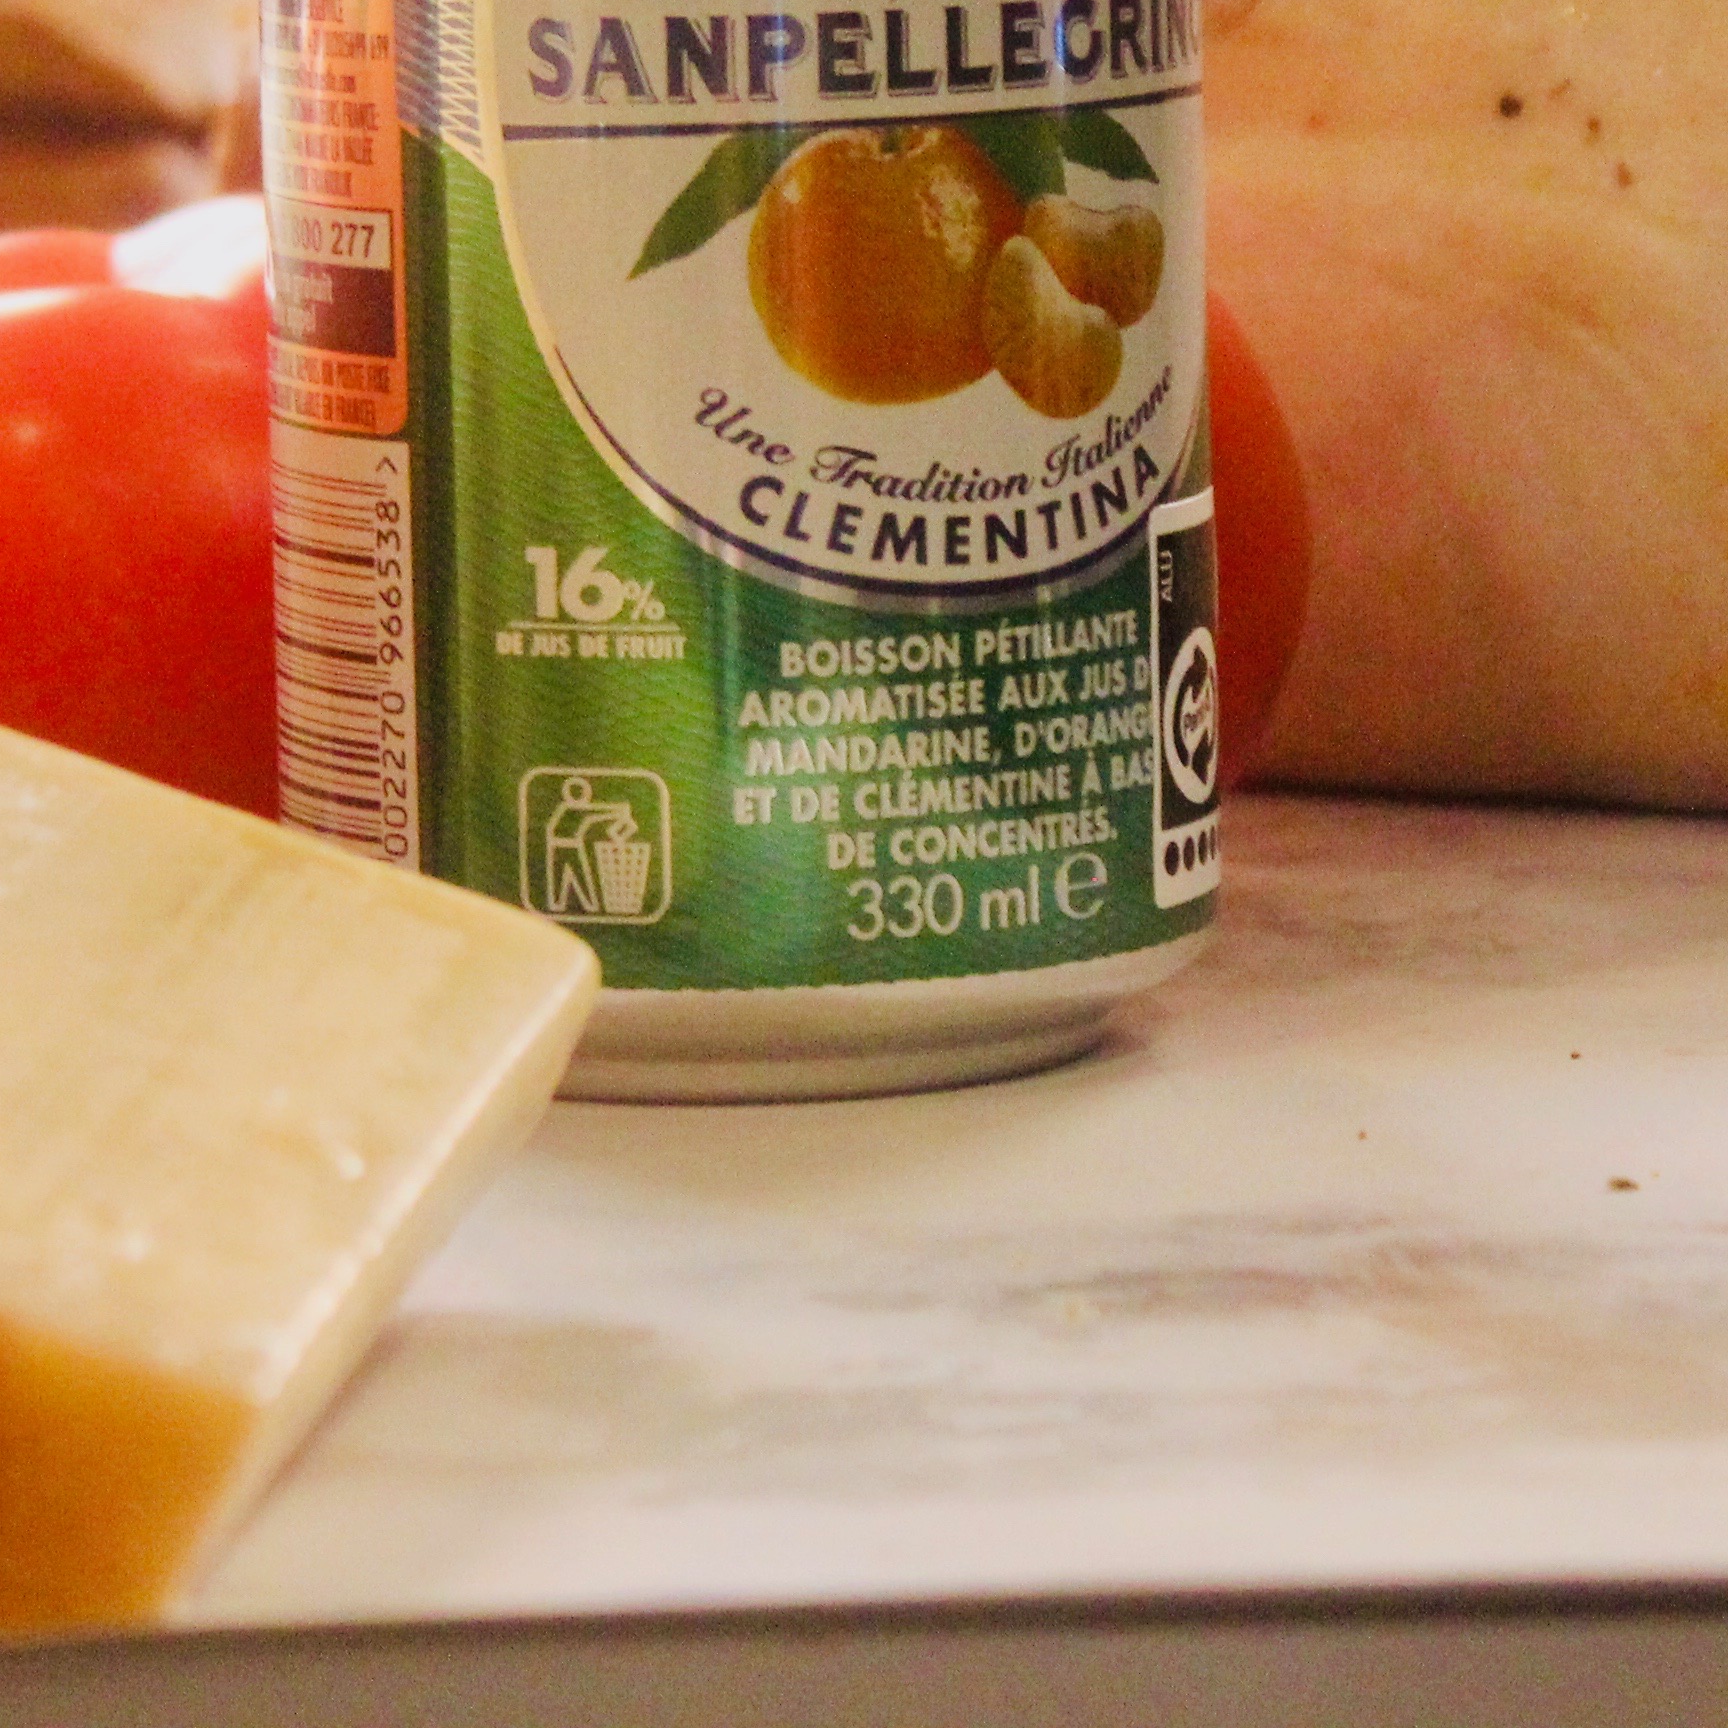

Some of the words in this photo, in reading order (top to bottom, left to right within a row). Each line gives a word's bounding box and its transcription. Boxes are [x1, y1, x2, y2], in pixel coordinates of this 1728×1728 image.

[330, 220, 374, 258] 277
[693, 386, 798, 466] Une
[810, 445, 1035, 504] Tradition
[1040, 363, 1172, 488] Italienne
[738, 443, 1161, 567] CLEMENTINA
[524, 546, 666, 621] 16%
[495, 630, 523, 656] DE
[530, 631, 572, 658] JUS
[578, 634, 609, 659] DE
[615, 634, 688, 660] FRUIT
[780, 632, 961, 678] BOISSON
[976, 609, 1138, 667] PÉTILLANTE
[738, 671, 986, 728] AROMATISÉE
[997, 670, 1070, 713] AUX
[1079, 658, 1127, 702] JUS
[1134, 654, 1150, 691] D
[744, 727, 1002, 777] MANDARINE,
[1014, 700, 1153, 758] D'ORANG
[732, 786, 777, 826] ET
[791, 784, 841, 824] DE
[853, 763, 1073, 821] CLÉMENTINE
[1080, 749, 1103, 797] À
[1110, 746, 1153, 791] BAS
[827, 830, 876, 871] DE
[889, 802, 1119, 866] CONCENTRÉS.
[846, 872, 965, 942] 330
[979, 864, 1041, 931] ml
